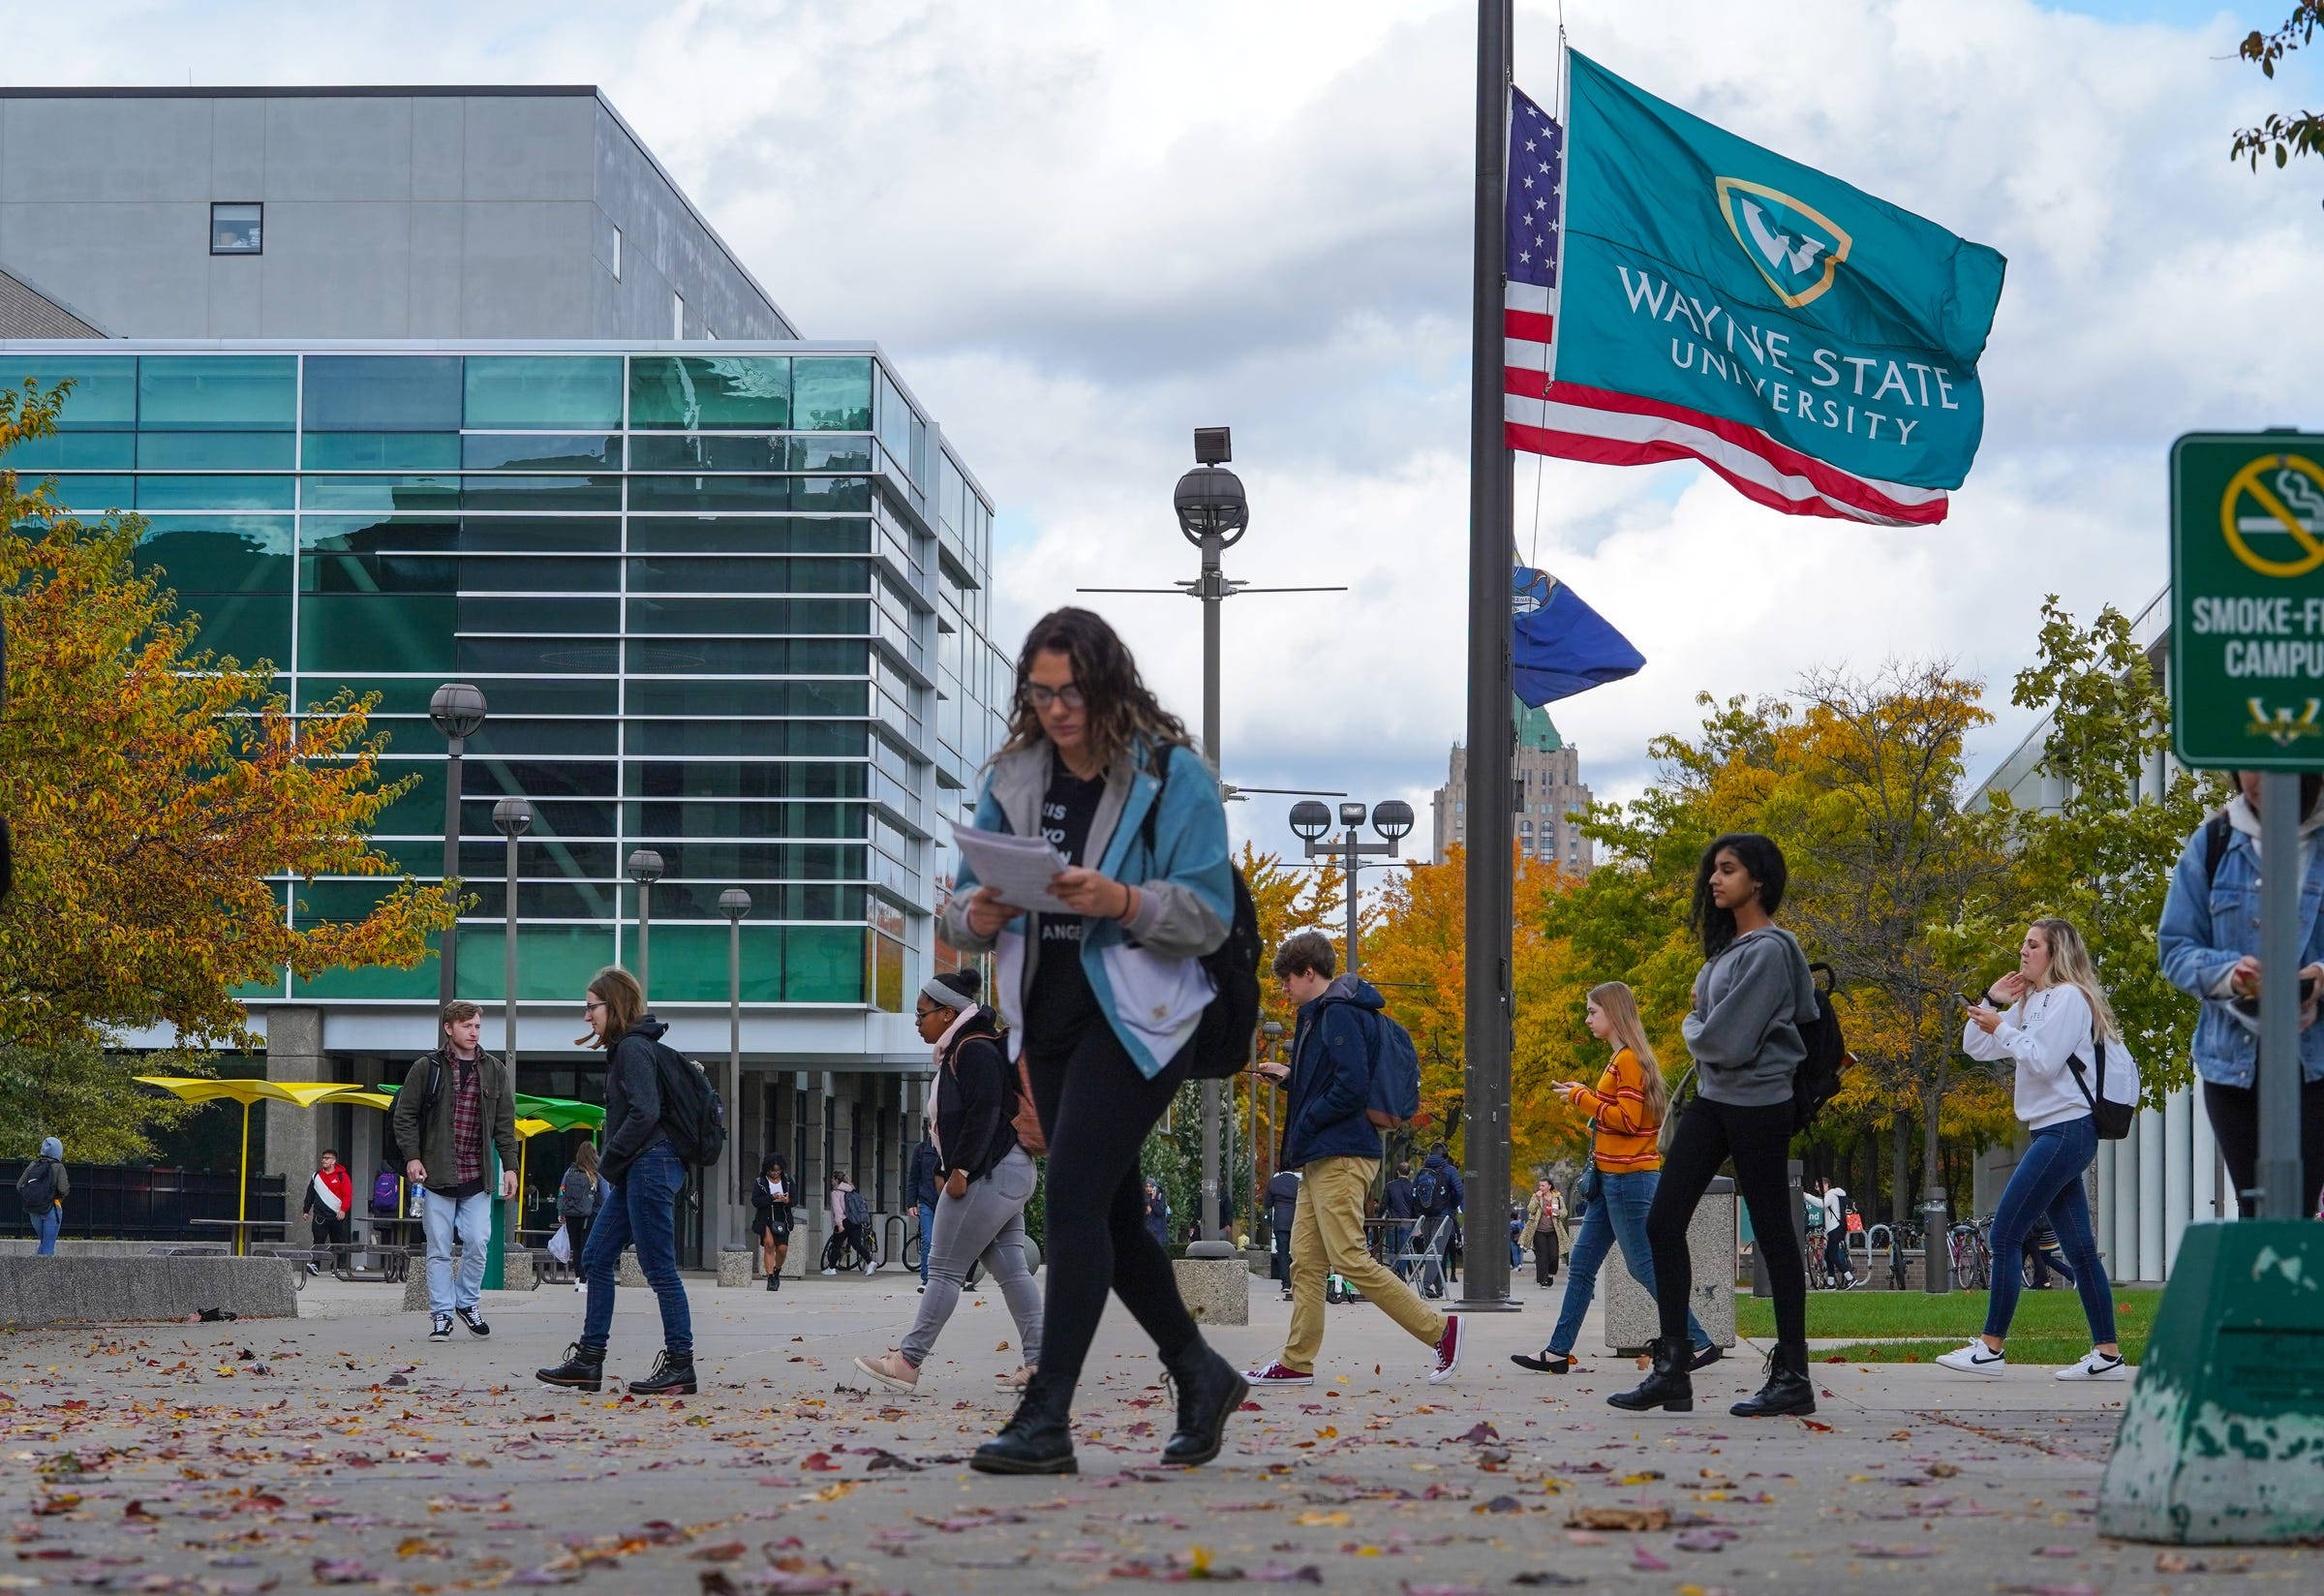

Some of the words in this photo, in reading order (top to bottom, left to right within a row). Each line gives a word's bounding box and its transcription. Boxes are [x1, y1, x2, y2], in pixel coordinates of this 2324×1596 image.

[1616, 265, 1793, 374] WAYNE
[1811, 349, 1959, 410] STATE
[1671, 338, 1919, 445] UNIVERSITY
